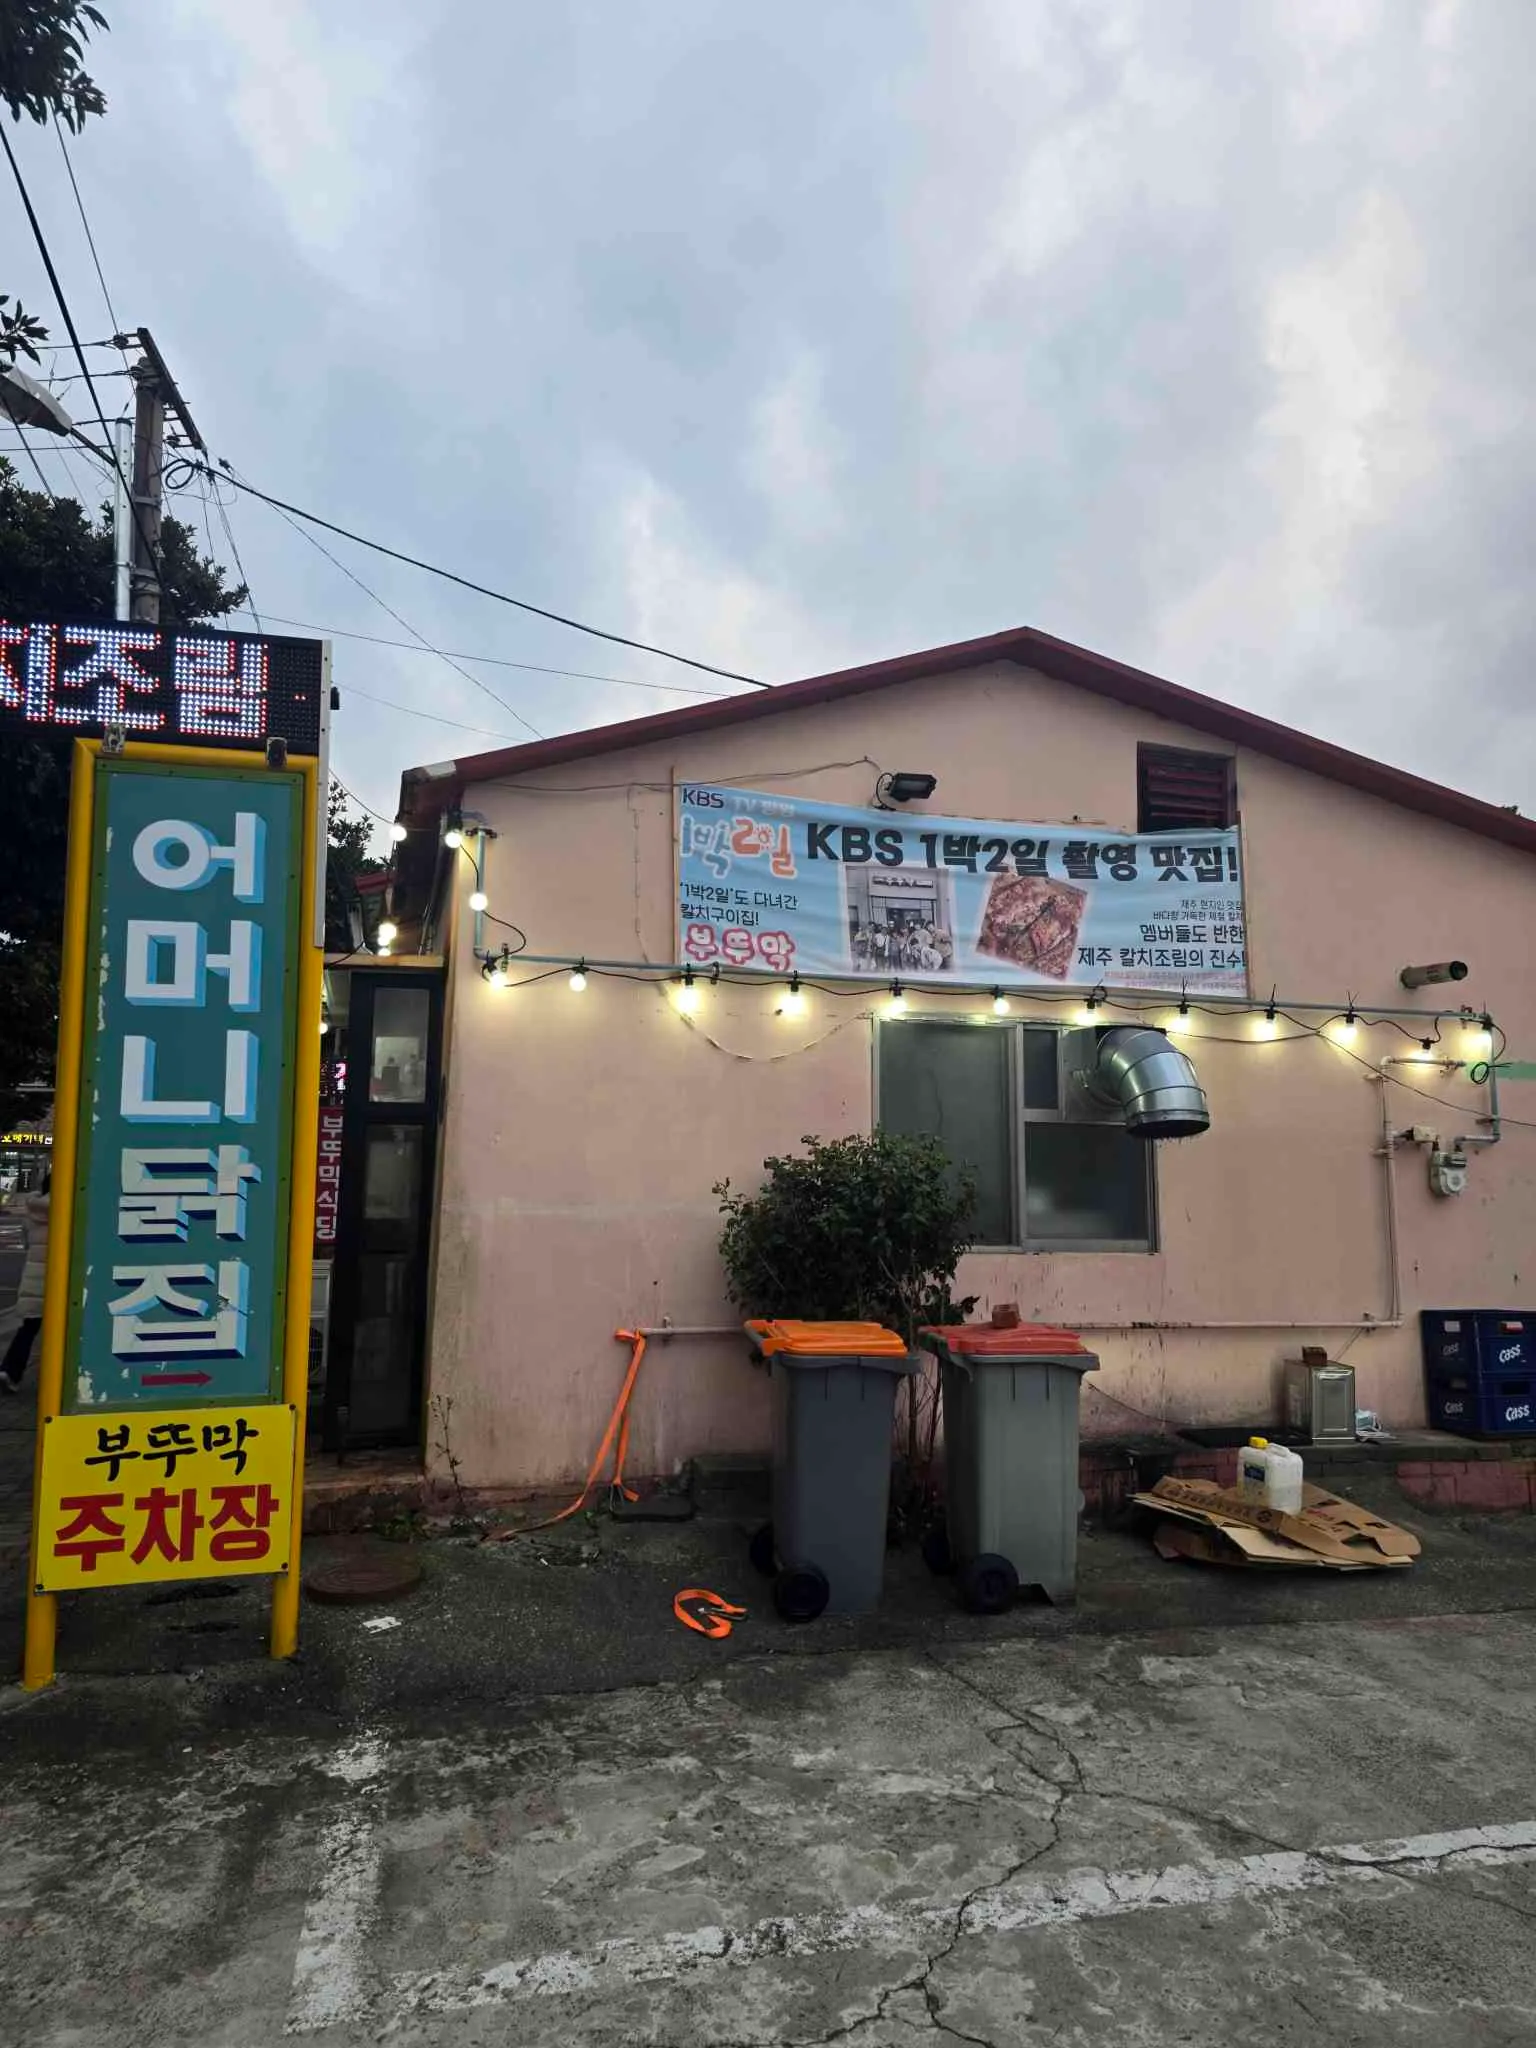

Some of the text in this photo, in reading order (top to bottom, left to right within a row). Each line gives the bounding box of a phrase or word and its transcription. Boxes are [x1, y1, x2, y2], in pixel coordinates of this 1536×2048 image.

[682, 787, 725, 809] KBS
[807, 822, 1238, 883] KBS 1박2일 촬영 맛집!
[753, 891, 799, 911] 다녀간
[685, 923, 797, 972] 부뚜막
[1078, 947, 1113, 968] 제주
[1119, 947, 1204, 969] 칼치조림의
[1139, 923, 1245, 945] 멤버들도 반한
[108, 811, 267, 1362] 어머니닭집
[84, 1417, 259, 1481] 부뚜막
[53, 1483, 280, 1572] 주차장
